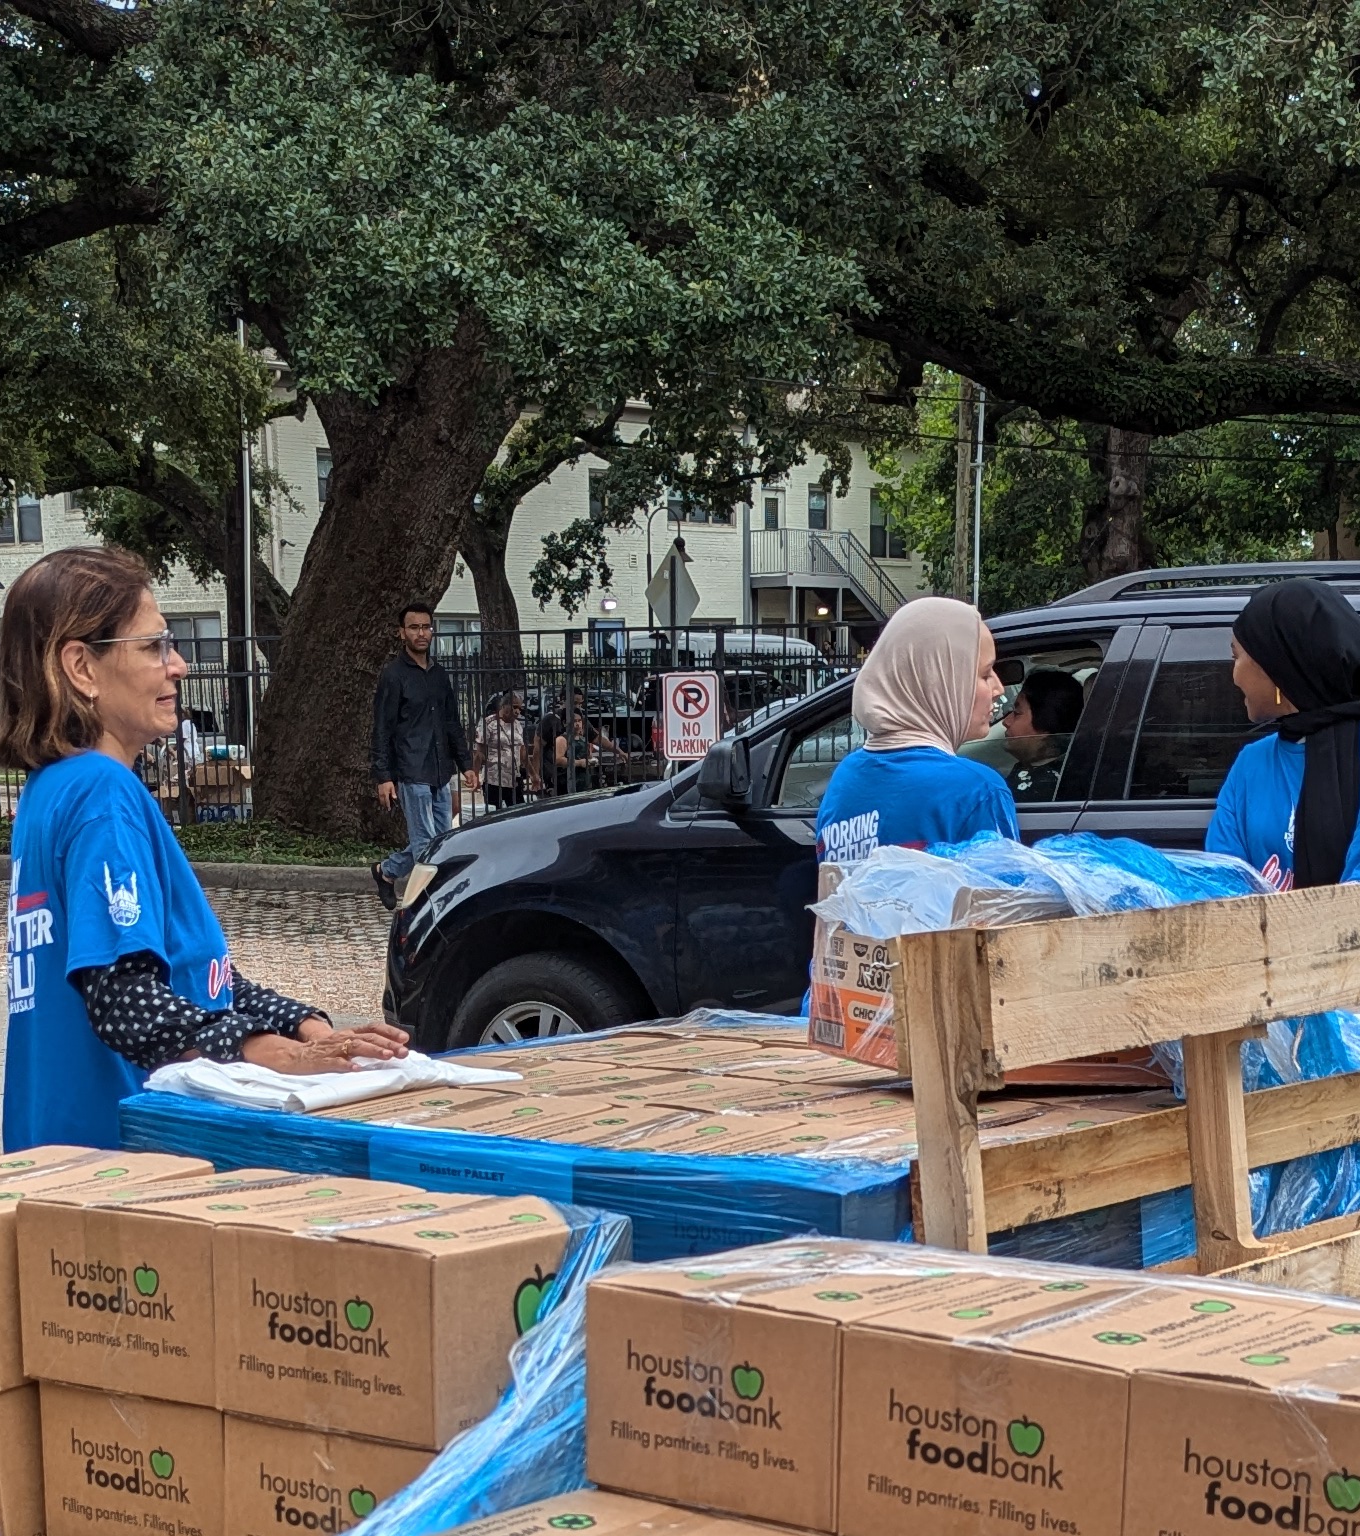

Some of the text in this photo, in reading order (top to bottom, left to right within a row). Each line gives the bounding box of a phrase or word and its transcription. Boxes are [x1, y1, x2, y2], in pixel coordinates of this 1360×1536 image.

[682, 721, 701, 737] NO
[822, 809, 880, 852] WORKING
[419, 1162, 506, 1183] Disaster PALLET
[50, 1247, 127, 1286] houston
[66, 1279, 175, 1322] foodbank
[252, 1277, 338, 1320] houston
[41, 1320, 74, 1345] Filling
[126, 1332, 160, 1358] Filling
[267, 1311, 390, 1359] foodbank
[239, 1353, 275, 1380] Filling
[334, 1368, 371, 1396] Filling
[627, 1338, 723, 1386] houston
[643, 1375, 782, 1431] foodbank
[888, 1387, 998, 1441] houston
[70, 1427, 144, 1468] houston
[610, 1420, 799, 1473] Filling pantries. Filling lives.
[906, 1427, 1064, 1491] foodbank
[1184, 1437, 1312, 1495] houston
[85, 1458, 191, 1505] foodbank
[260, 1461, 342, 1507] houston
[62, 1496, 93, 1521] Filling
[275, 1496, 351, 1533] foodb
[867, 1473, 1081, 1536] Filling pantries. Filling lives.
